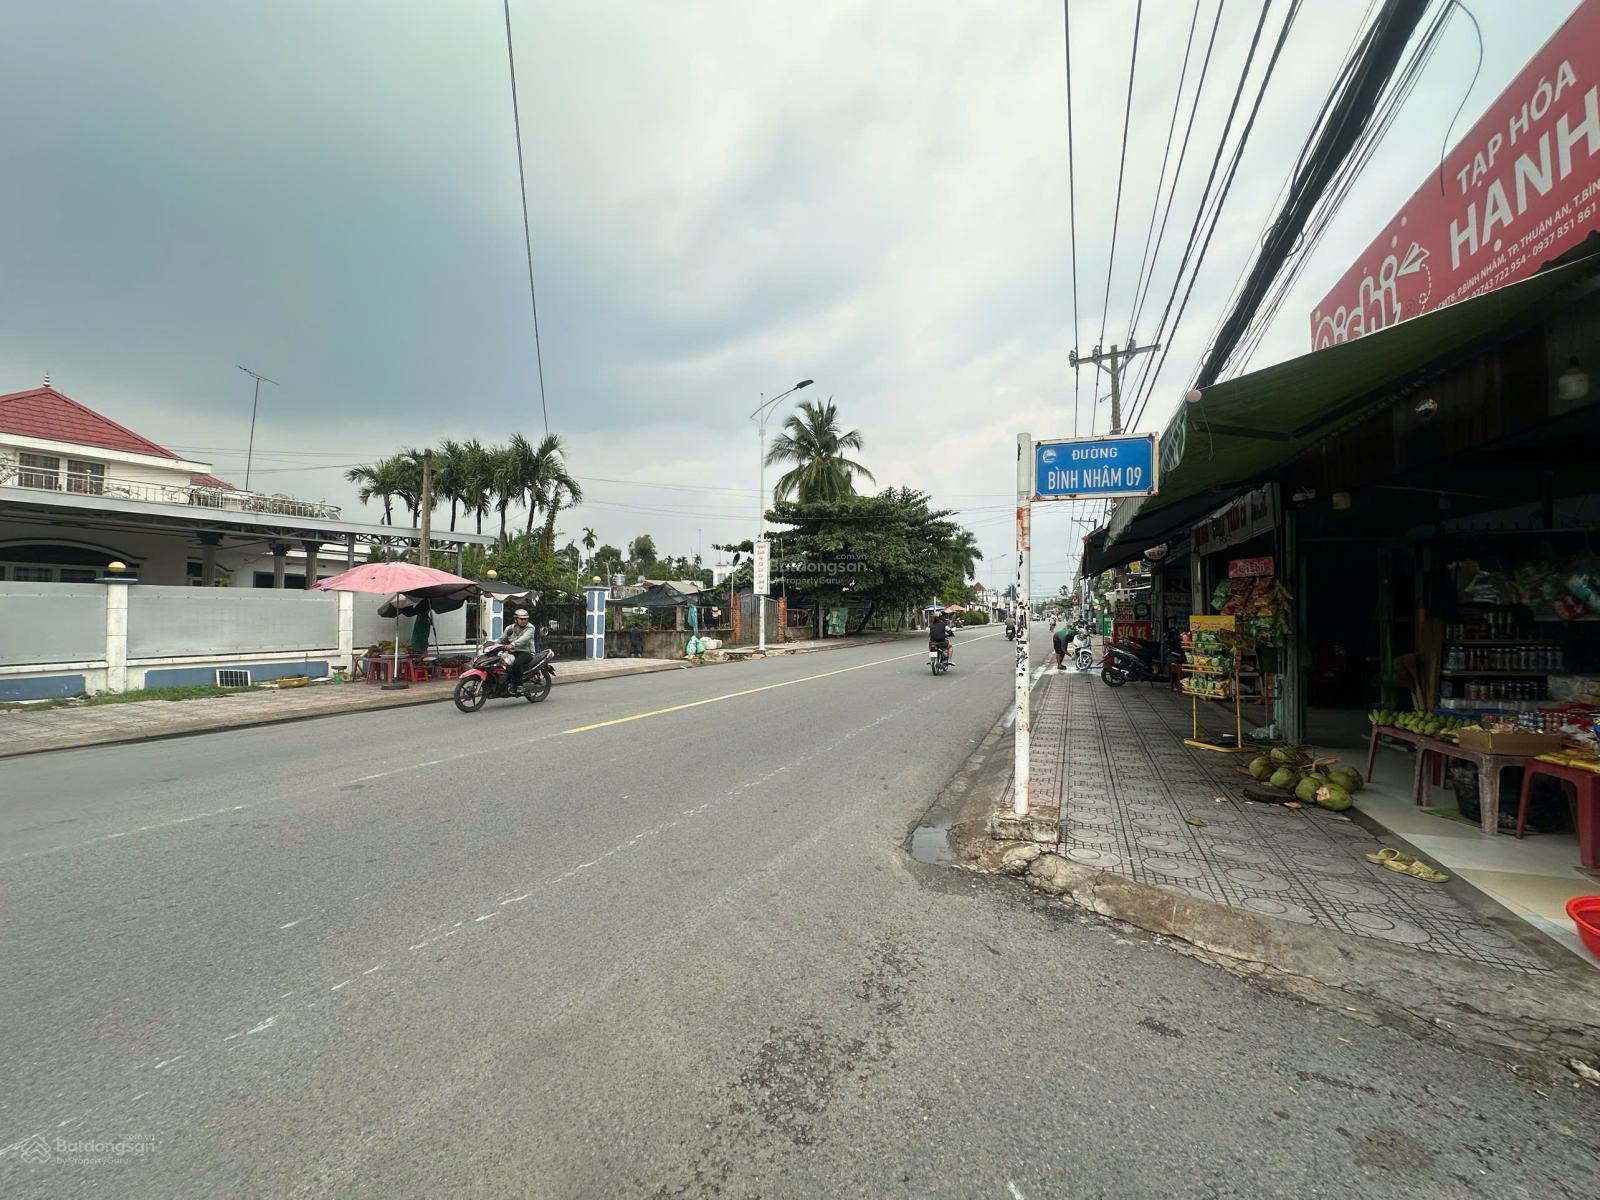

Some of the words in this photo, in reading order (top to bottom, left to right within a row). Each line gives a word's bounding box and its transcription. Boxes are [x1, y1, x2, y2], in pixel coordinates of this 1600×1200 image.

[1457, 132, 1502, 195] TẠP
[1509, 60, 1577, 147] HÓA
[1450, 85, 1600, 271] HẠNH
[1554, 203, 1572, 223] AN,
[1494, 268, 1510, 284] 722
[1510, 256, 1526, 272] 954
[1532, 232, 1555, 256] 0937
[1557, 218, 1574, 238] 851
[1577, 201, 1596, 224] 861
[1048, 466, 1078, 489] BÌNH
[1083, 465, 1121, 488] NHÂM
[1126, 466, 1141, 486] 09
[1072, 446, 1117, 460] ĐƯỜNG
